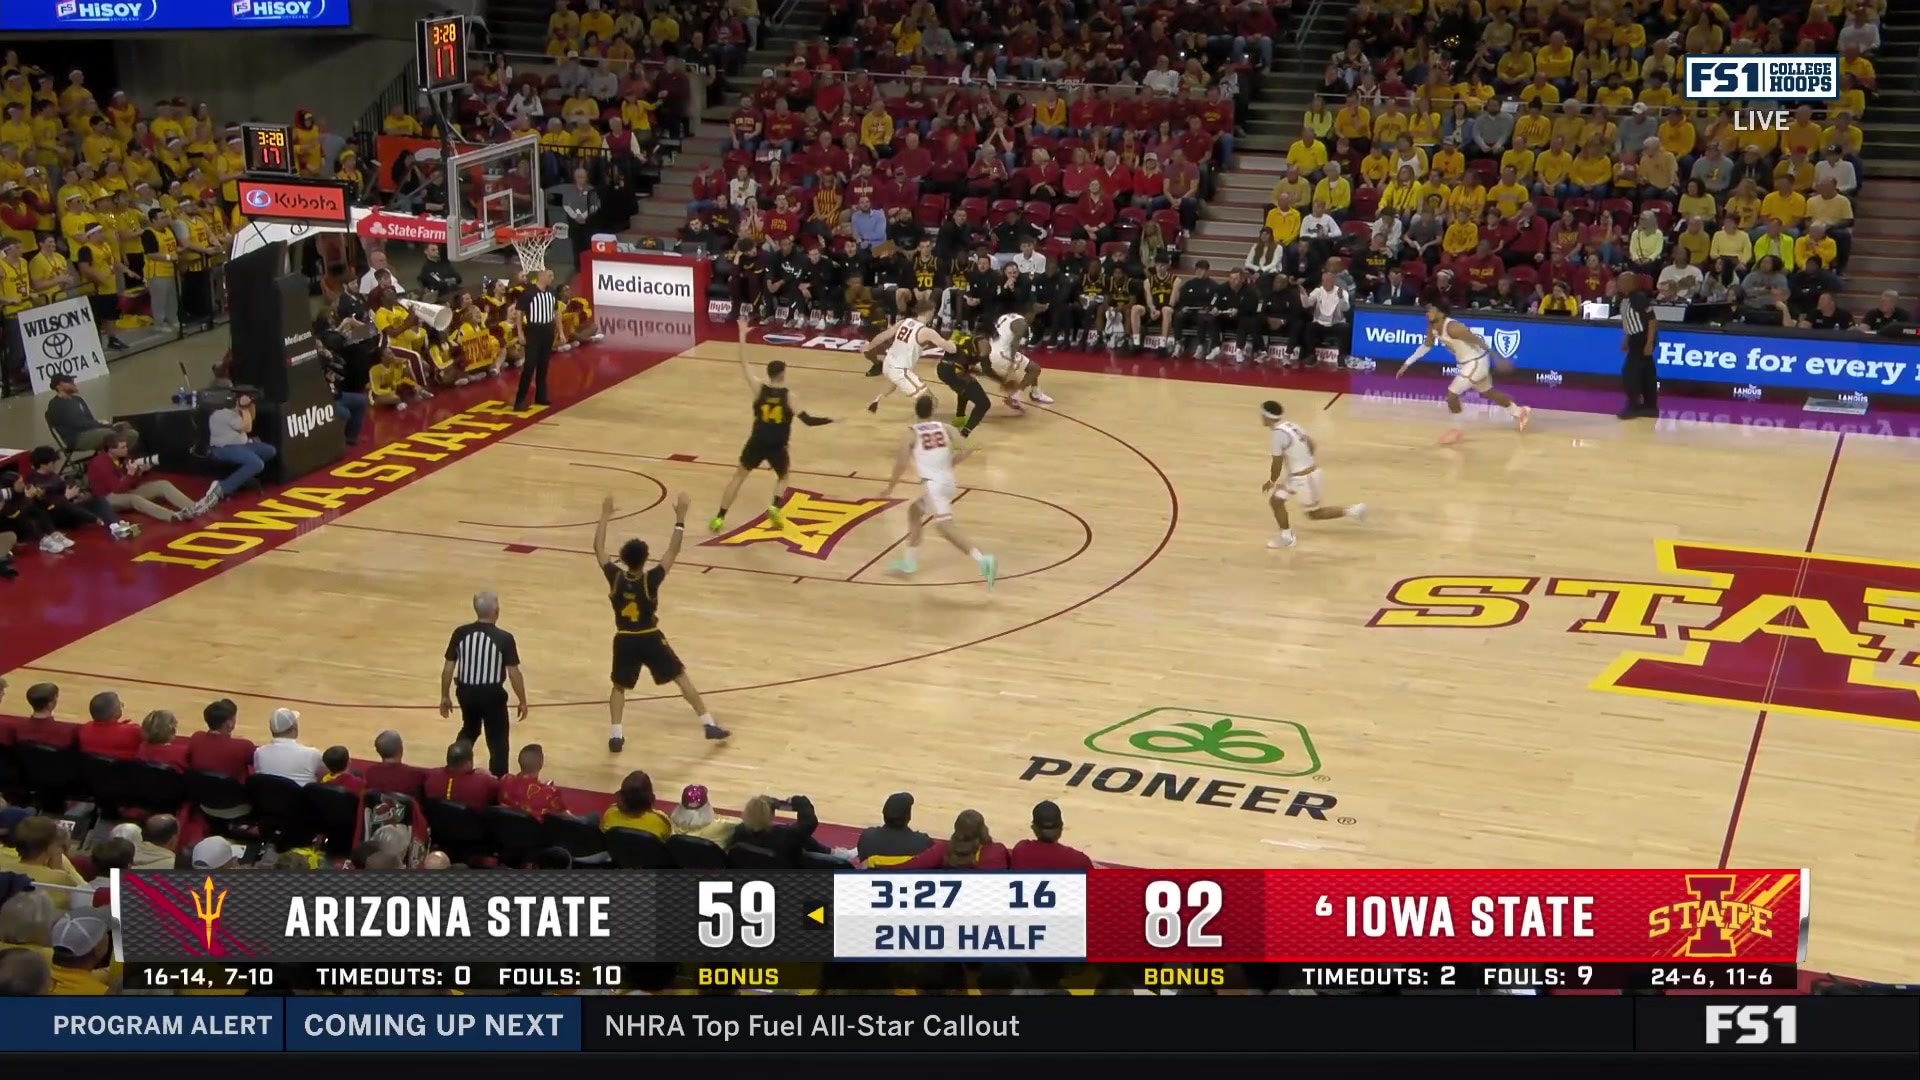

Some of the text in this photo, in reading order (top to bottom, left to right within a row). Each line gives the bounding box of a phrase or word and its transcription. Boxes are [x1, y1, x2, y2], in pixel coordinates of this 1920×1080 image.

[79, 2, 143, 17] HiSOY
[254, 1, 312, 15] HiSOY
[433, 23, 457, 46] 3:28
[437, 45, 455, 79] 17
[258, 131, 285, 147] 3:28
[263, 147, 281, 165] 17
[274, 191, 339, 211] Kubota
[387, 222, 446, 240] State Farm
[596, 241, 606, 253] G
[598, 274, 691, 297] Mediacom
[23, 311, 81, 338] WILSON
[36, 355, 90, 381] TOYOTA
[1657, 341, 1737, 369] Here
[1746, 347, 1797, 374] for
[1805, 357, 1906, 386] every
[760, 404, 785, 424] 14
[921, 431, 946, 451] 22
[130, 399, 551, 571] IOWA STATE
[621, 601, 640, 622] 4
[1019, 755, 1339, 821] PIONEER
